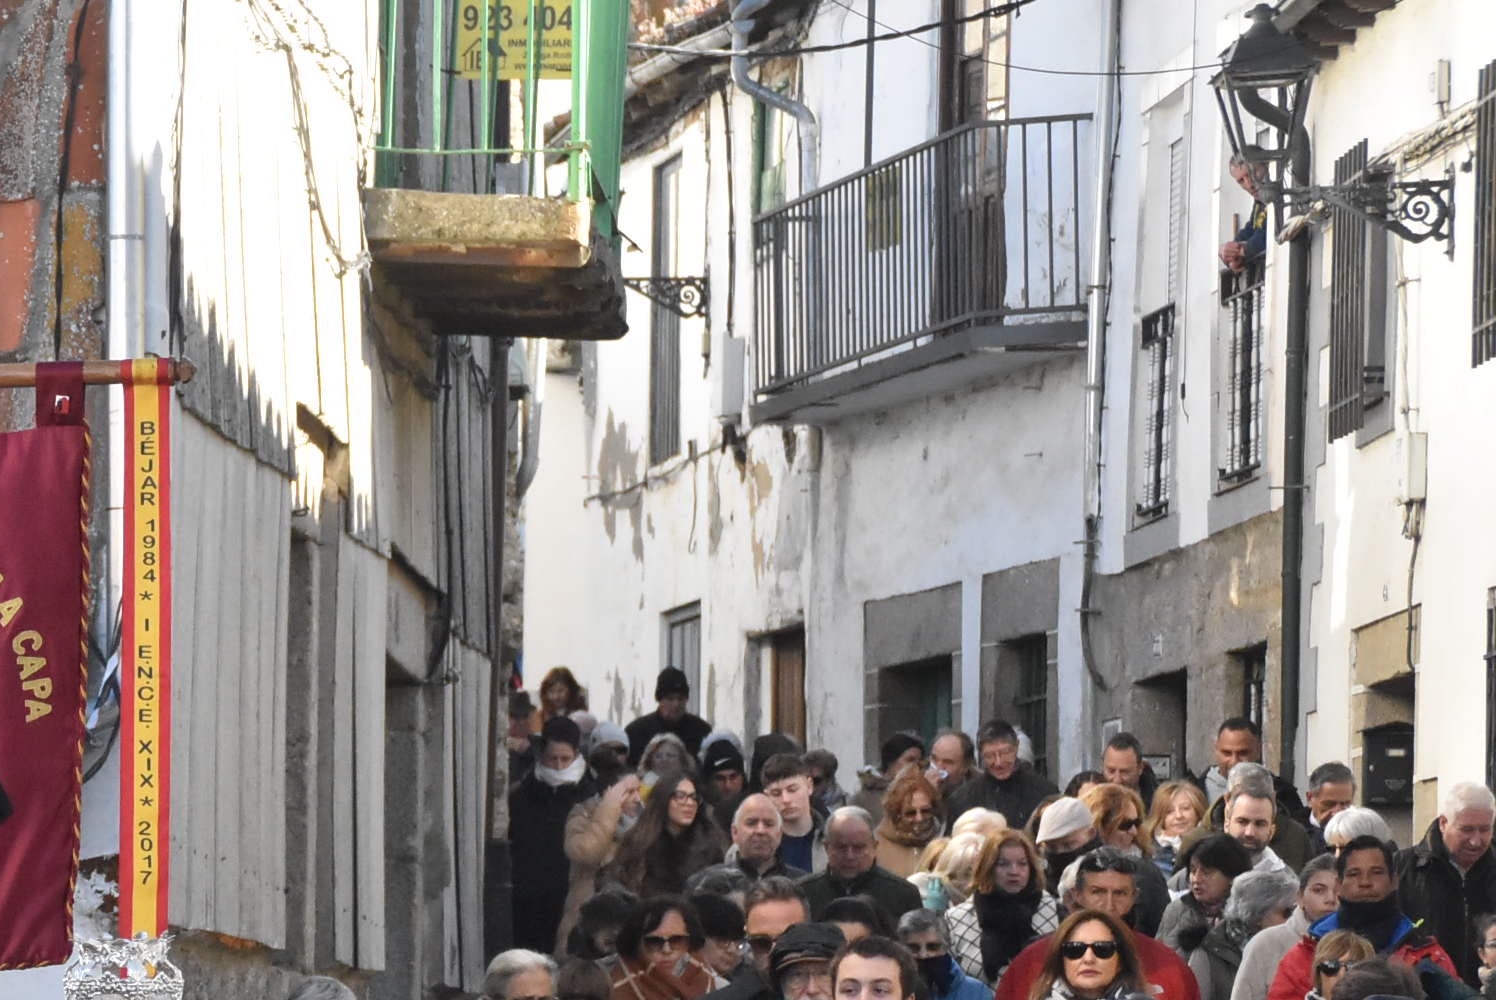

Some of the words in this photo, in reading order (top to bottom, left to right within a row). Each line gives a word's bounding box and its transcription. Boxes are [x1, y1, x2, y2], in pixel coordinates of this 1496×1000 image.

[140, 421, 157, 506] BÉJAR
[142, 519, 157, 583] 1984
[144, 618, 150, 632] I
[12, 630, 53, 722] CAPA
[138, 739, 154, 788] XIX
[138, 821, 153, 885] 2017
